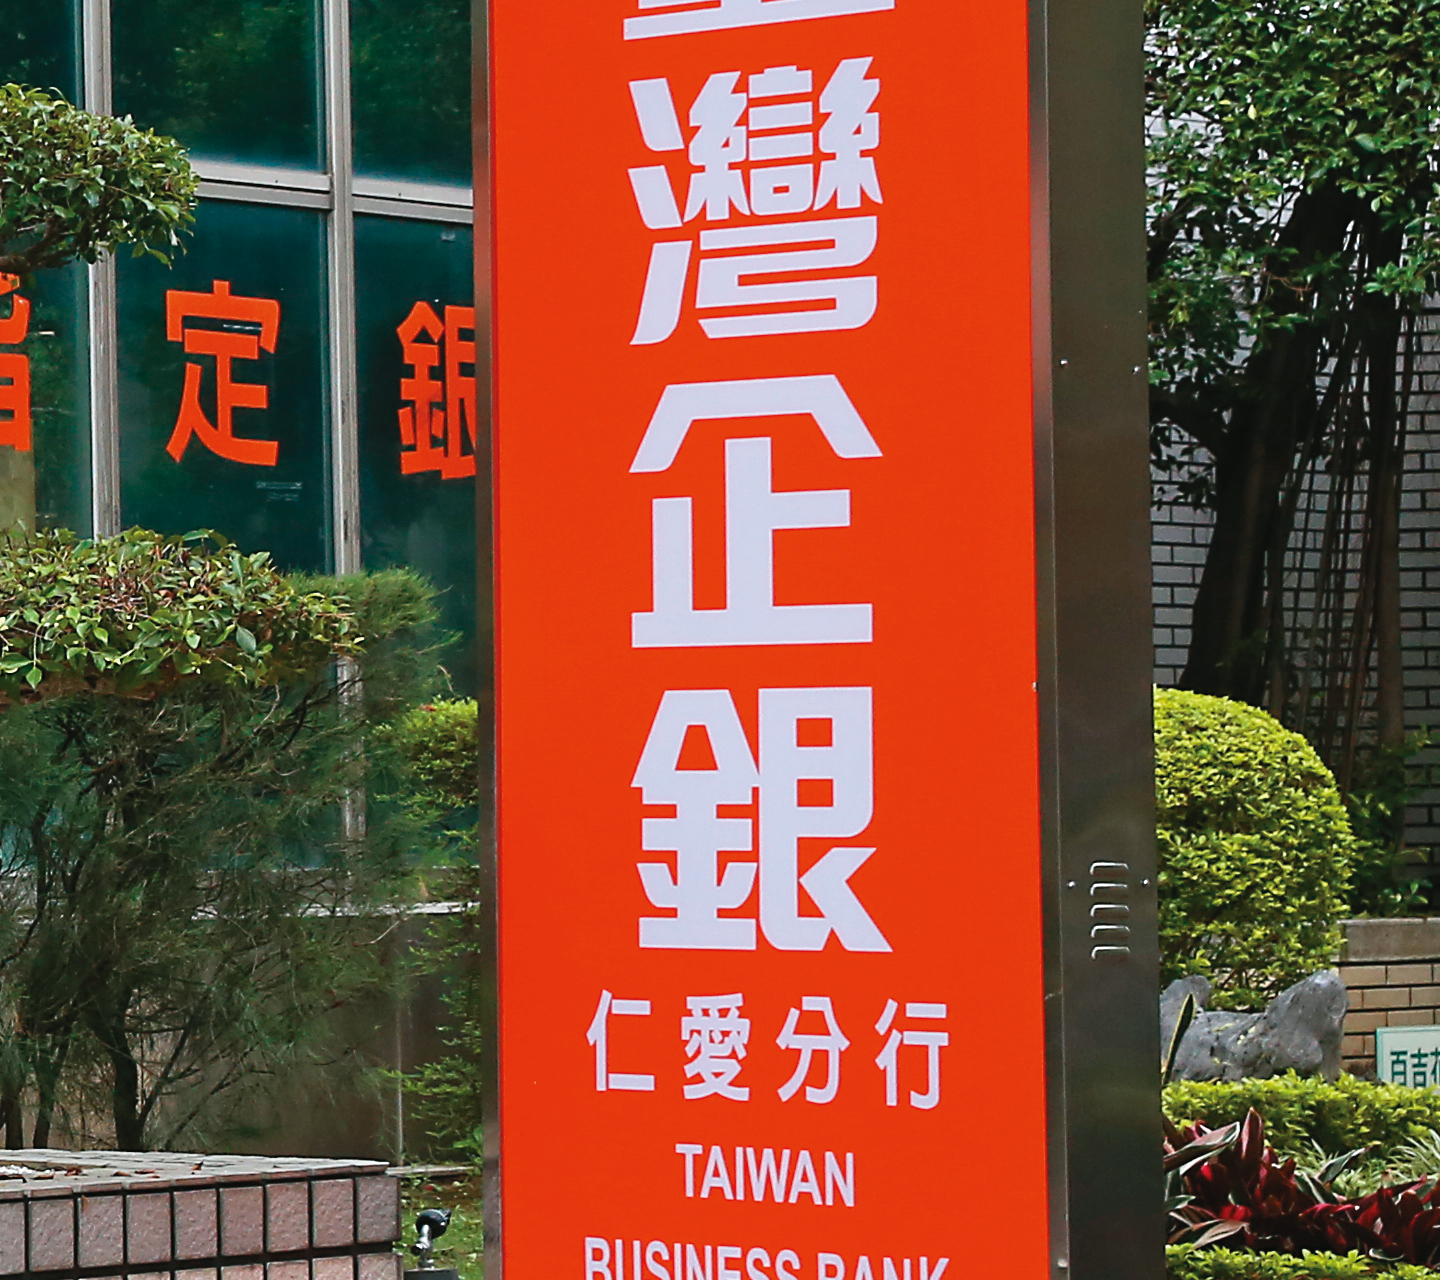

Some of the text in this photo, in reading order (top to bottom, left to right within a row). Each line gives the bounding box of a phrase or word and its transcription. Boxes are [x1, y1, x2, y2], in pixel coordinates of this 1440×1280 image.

[586, 989, 950, 1110] 仁愛分行
[675, 1143, 855, 1207] TAIWAN
